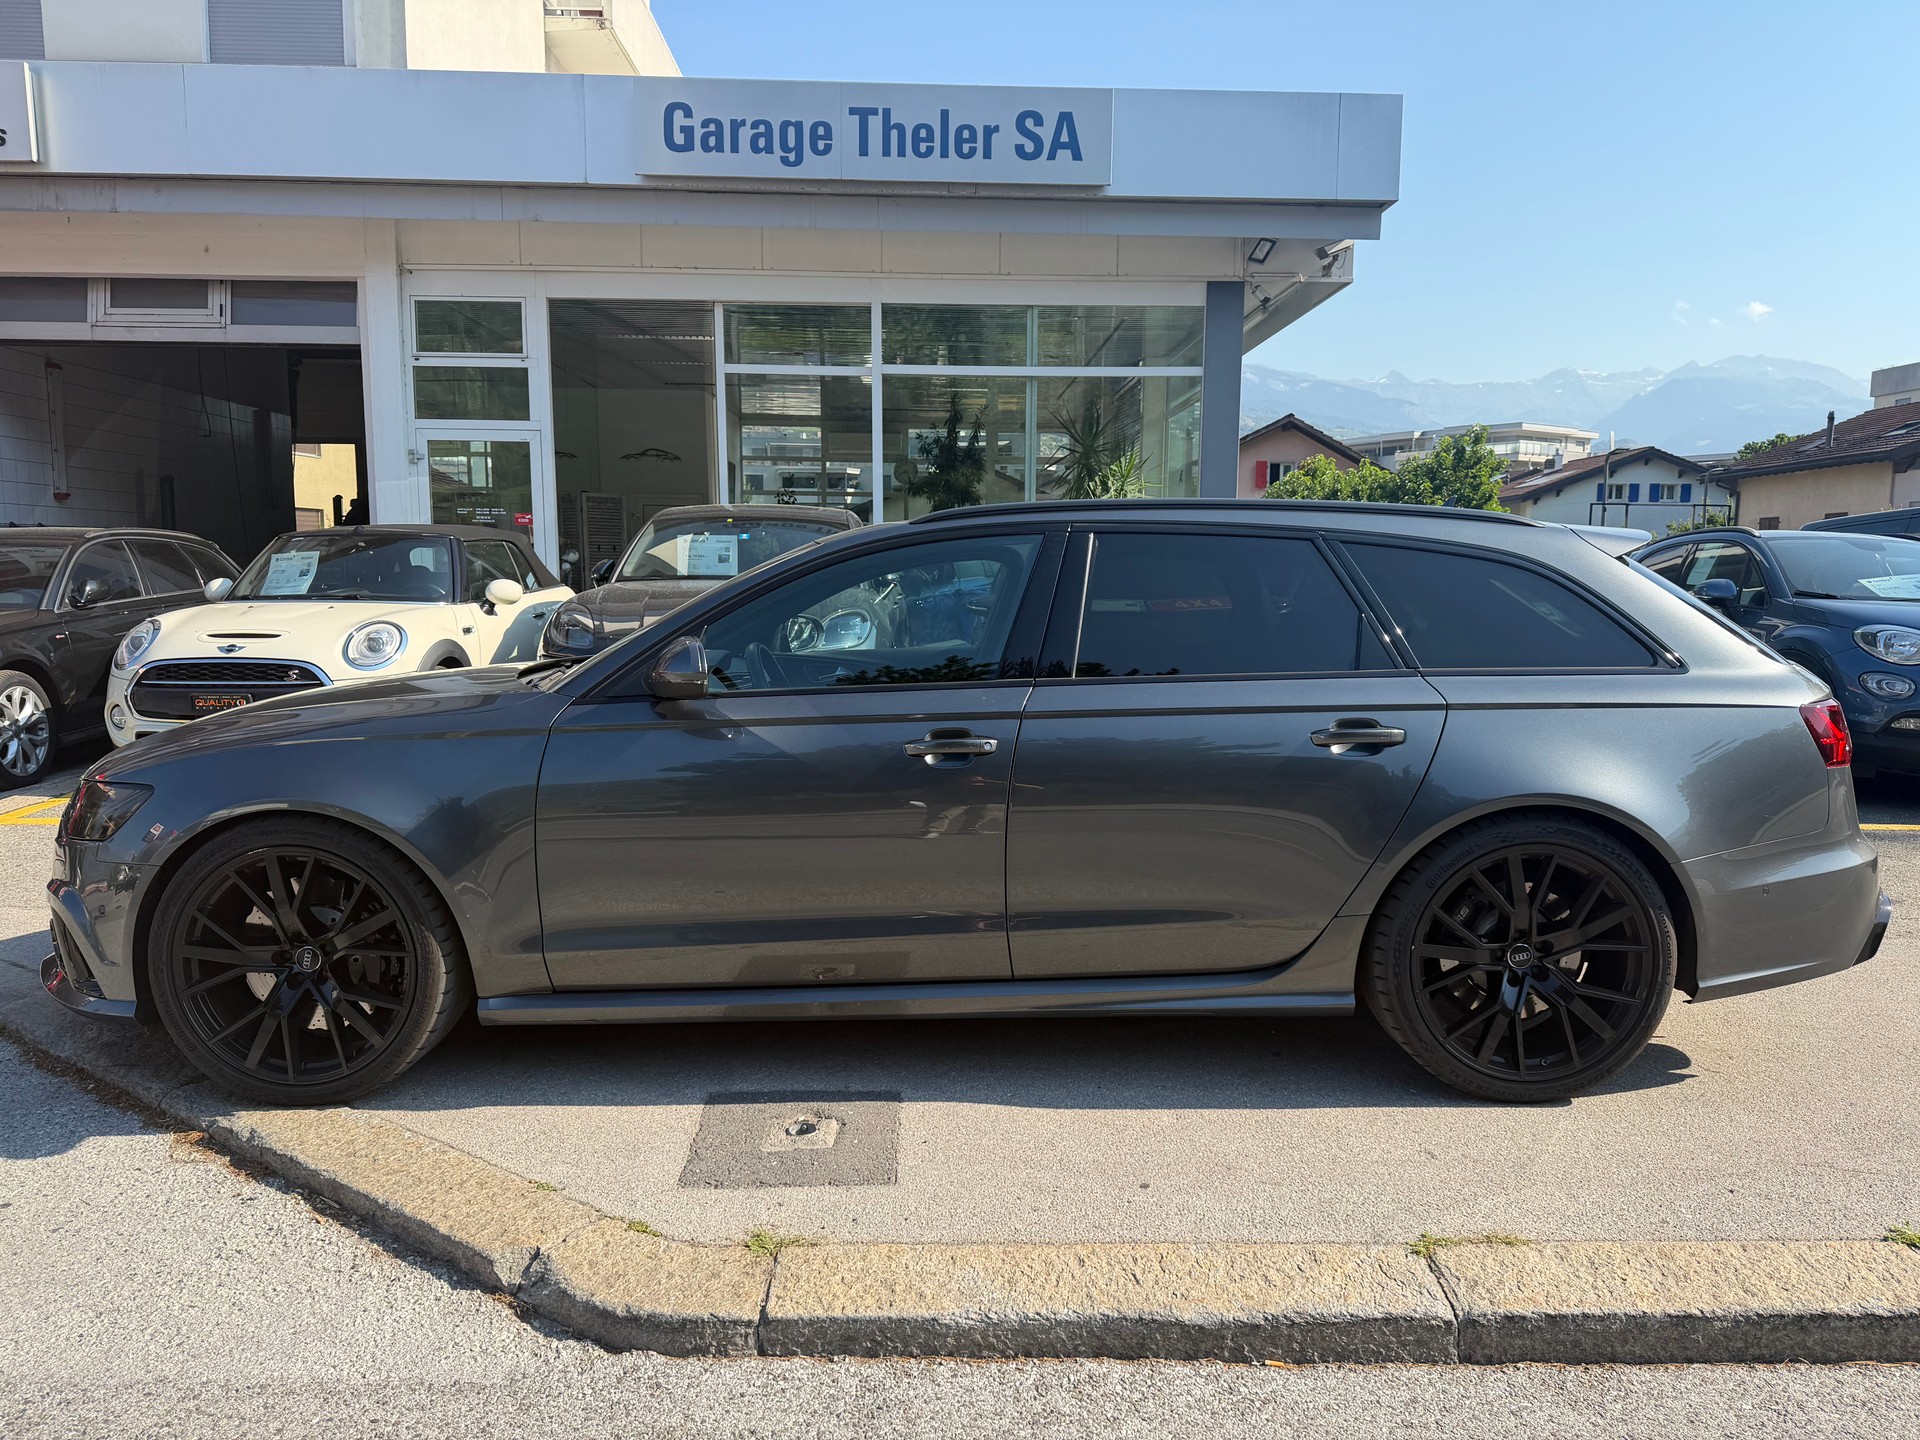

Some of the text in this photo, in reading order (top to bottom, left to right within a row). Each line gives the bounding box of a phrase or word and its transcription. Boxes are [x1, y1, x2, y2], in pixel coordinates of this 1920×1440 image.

[663, 101, 1083, 167] Garage Theler SA
[1425, 845, 1475, 889] Continental
[1656, 904, 1673, 977] SportContact
